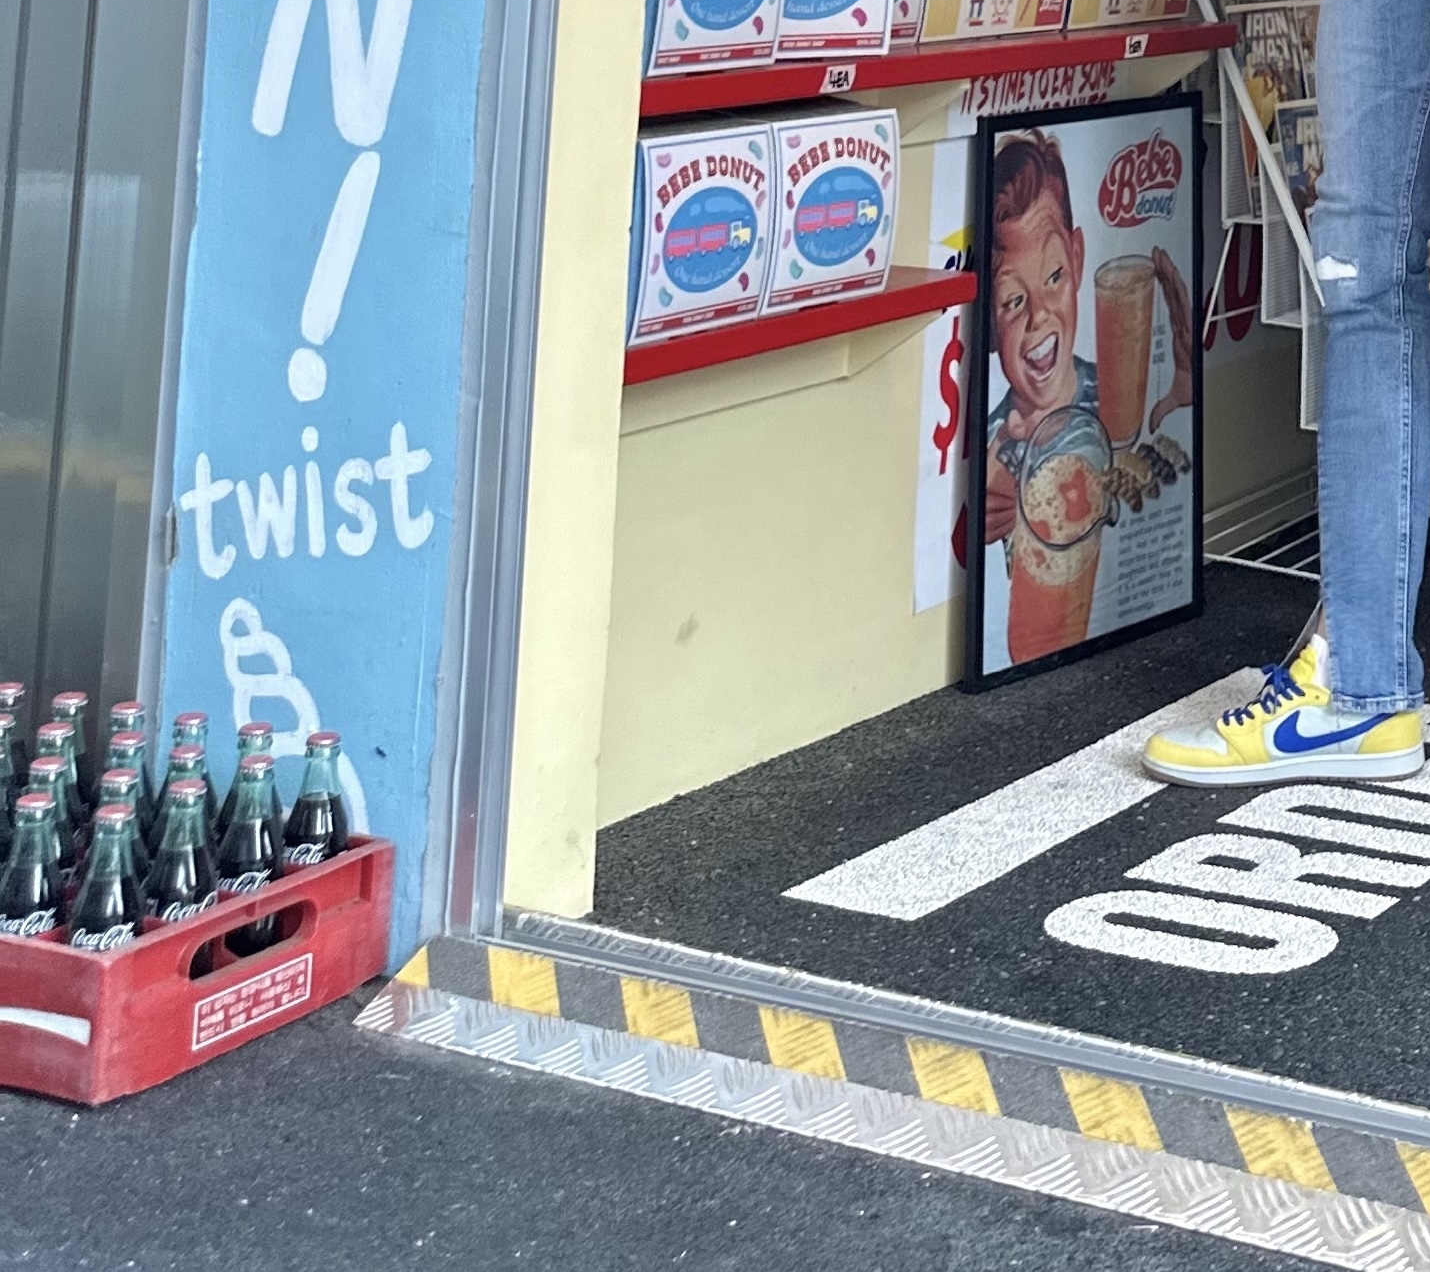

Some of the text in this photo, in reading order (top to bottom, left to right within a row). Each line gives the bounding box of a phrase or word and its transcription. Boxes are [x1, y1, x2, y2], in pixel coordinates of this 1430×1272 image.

[657, 155, 766, 208] BEBE DONUT
[787, 136, 891, 187] BEBE DONUT
[1104, 129, 1178, 224] Bebe
[1135, 192, 1175, 221] donut
[181, 420, 434, 580] twist
